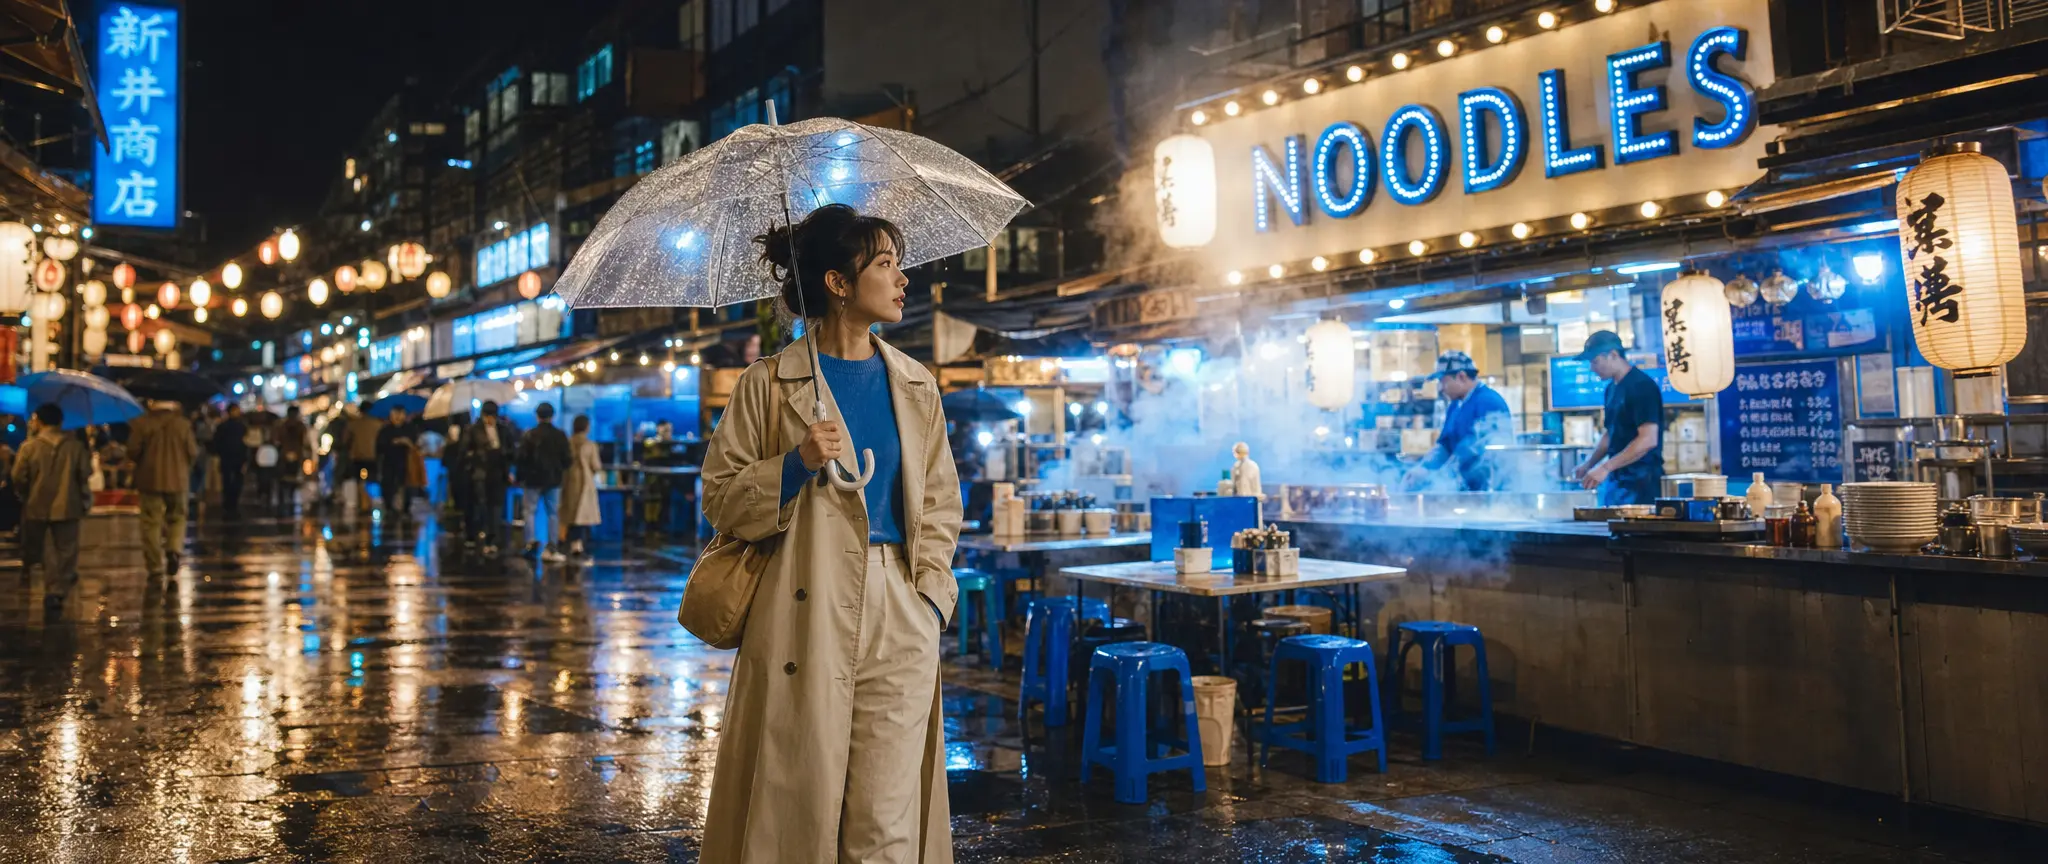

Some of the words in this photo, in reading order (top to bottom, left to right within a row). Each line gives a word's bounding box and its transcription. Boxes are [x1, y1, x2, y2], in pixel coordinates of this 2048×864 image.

[104, 6, 169, 218] 新井商店
[1251, 25, 1756, 232] NOODLES
